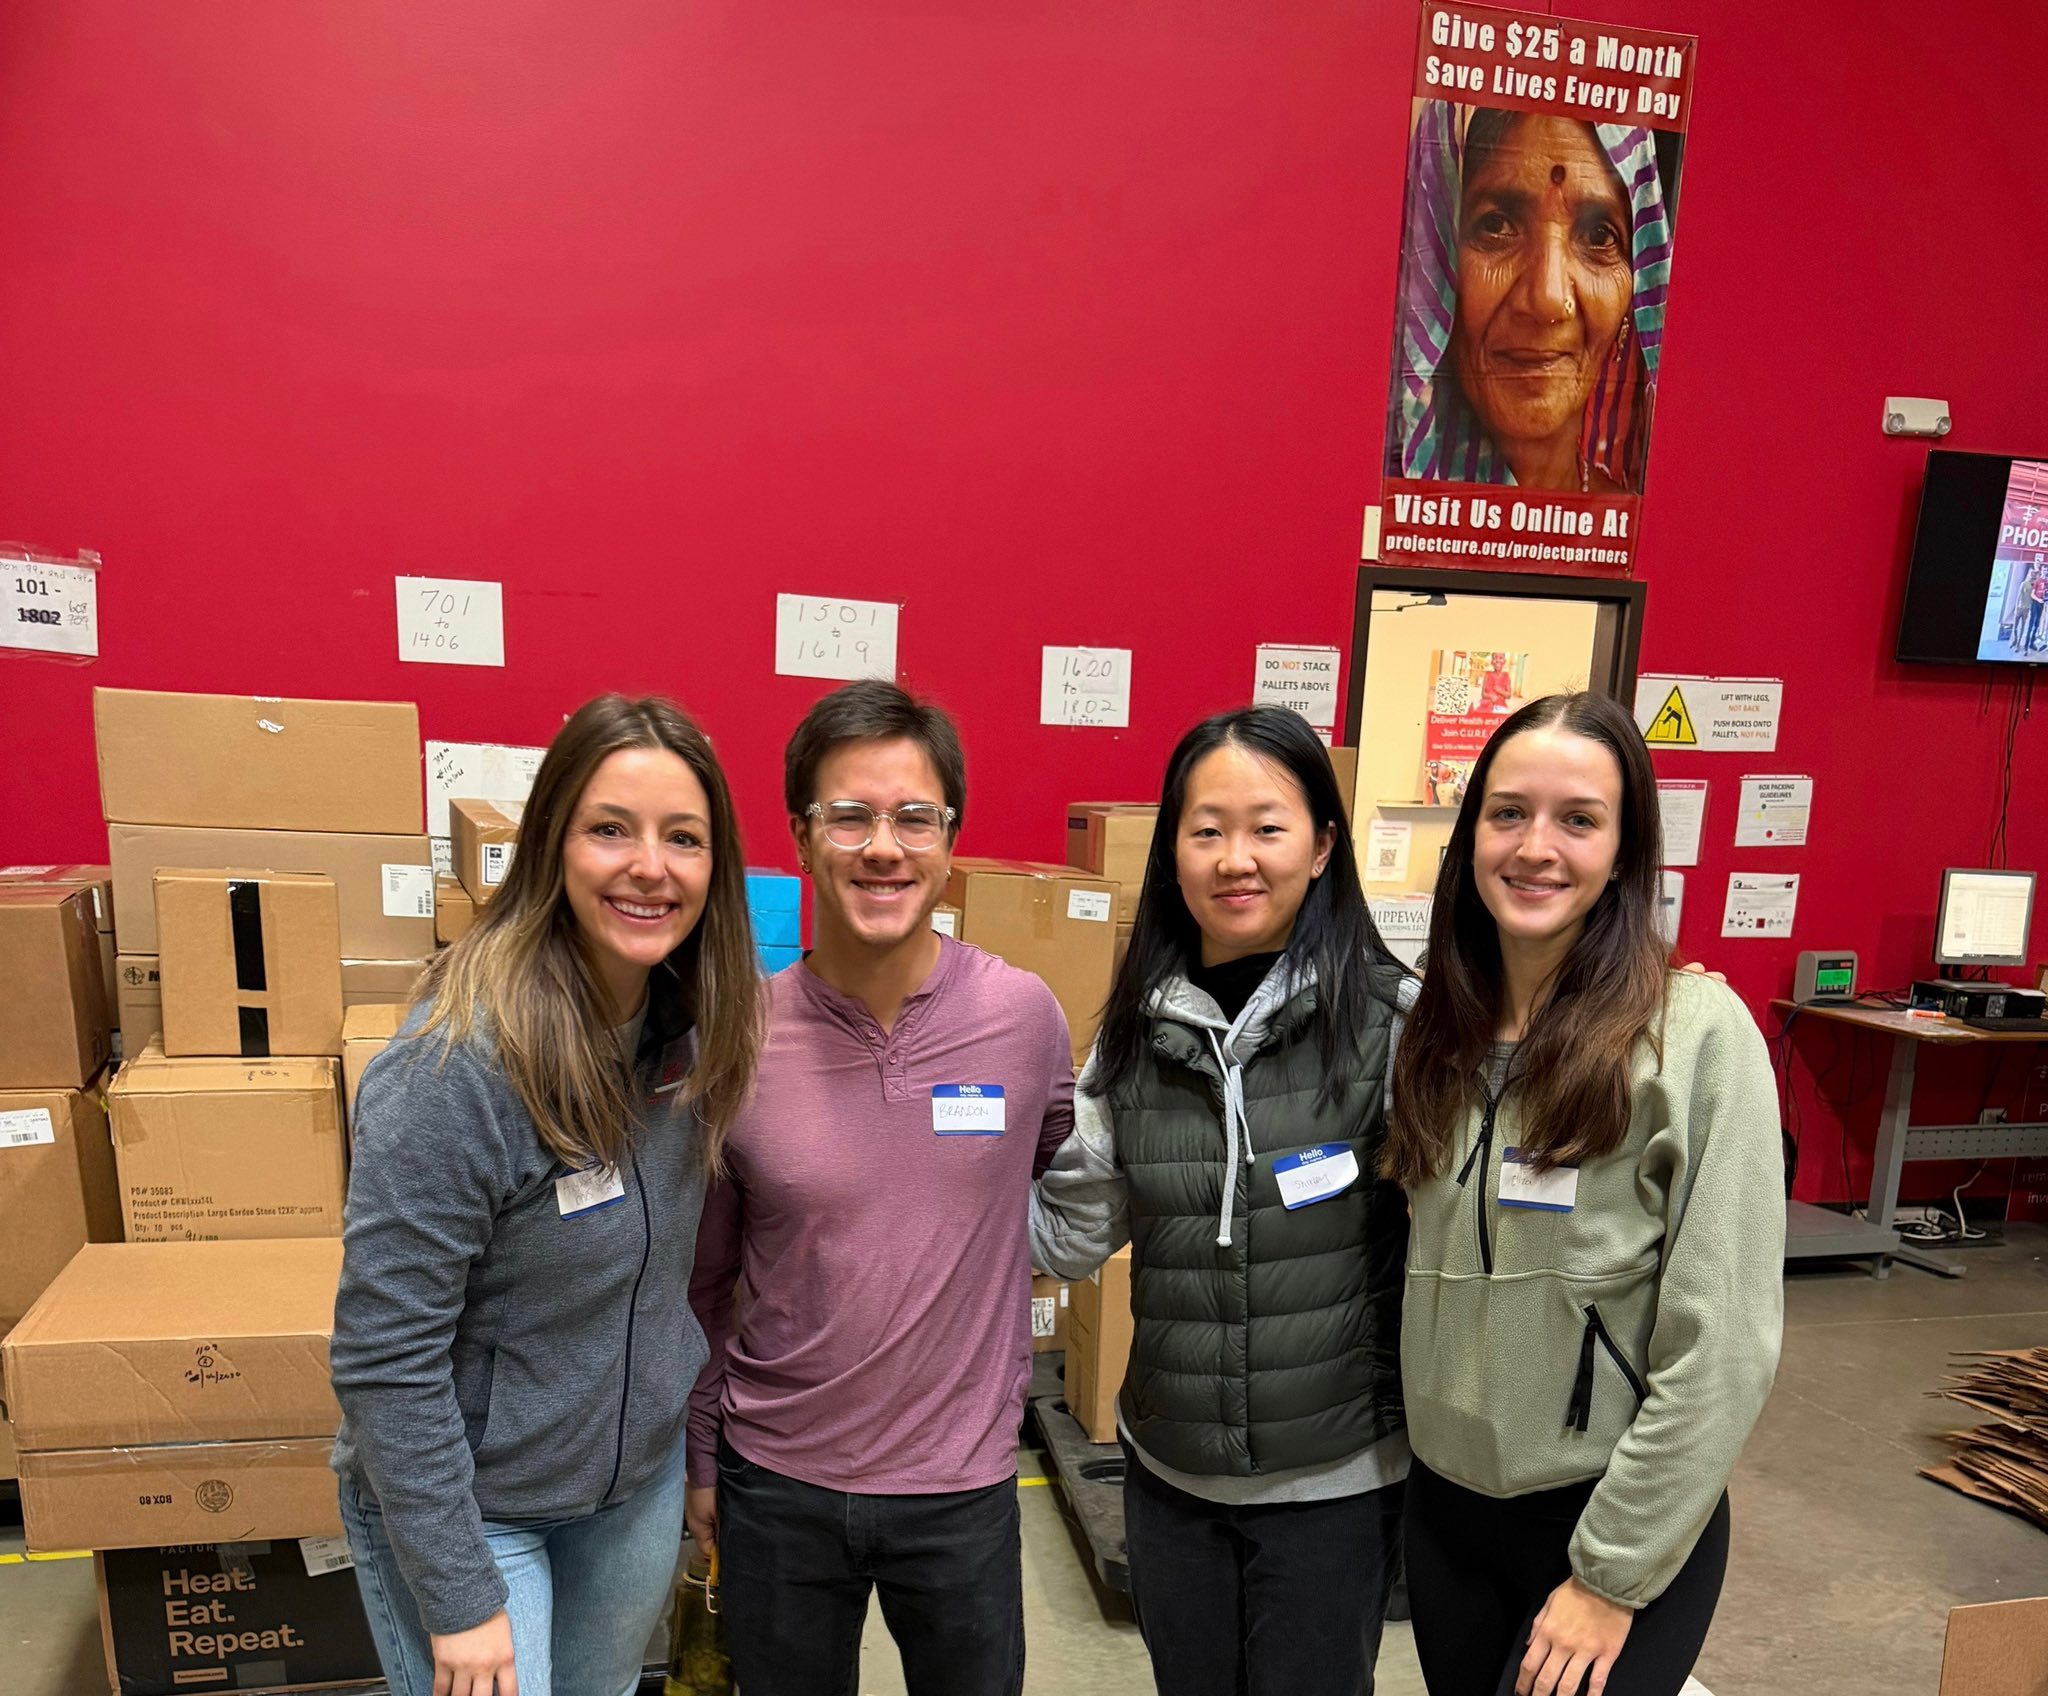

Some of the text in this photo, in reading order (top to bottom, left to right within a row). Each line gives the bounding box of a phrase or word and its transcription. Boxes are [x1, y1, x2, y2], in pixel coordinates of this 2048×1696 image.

[1432, 11, 1683, 79] Give $25 a Month
[1425, 55, 1681, 120] Save Lives Every Day
[1394, 494, 1629, 539] Visit Us Online At
[1385, 534, 1629, 565] projectcure.org/projectpartners
[15, 578, 49, 596] 101
[420, 590, 471, 616] 701
[434, 617, 450, 629] to
[799, 603, 876, 626] 1501
[412, 632, 459, 650] 1406
[798, 640, 869, 664] 1619
[1062, 656, 1113, 678] 1620
[1265, 660, 1331, 672] DO NOT STACK
[1062, 682, 1077, 695] to
[1261, 680, 1331, 692] PALLETS ABOVE
[1288, 700, 1310, 711] FEET
[1721, 693, 1734, 701] LIFT
[1753, 694, 1770, 702] LEGS,
[1728, 704, 1760, 712] NOT BACK
[1713, 720, 1772, 728] PUSH BOXES ONTO
[959, 1084, 982, 1094] Hello
[1299, 1149, 1324, 1162] Hello
[133, 1211, 162, 1220] Product
[207, 1208, 228, 1218] Large
[153, 1494, 172, 1504] BOX
[162, 1567, 256, 1596] Heat.
[165, 1599, 235, 1627] Eat.
[168, 1623, 304, 1660] Repeat.
